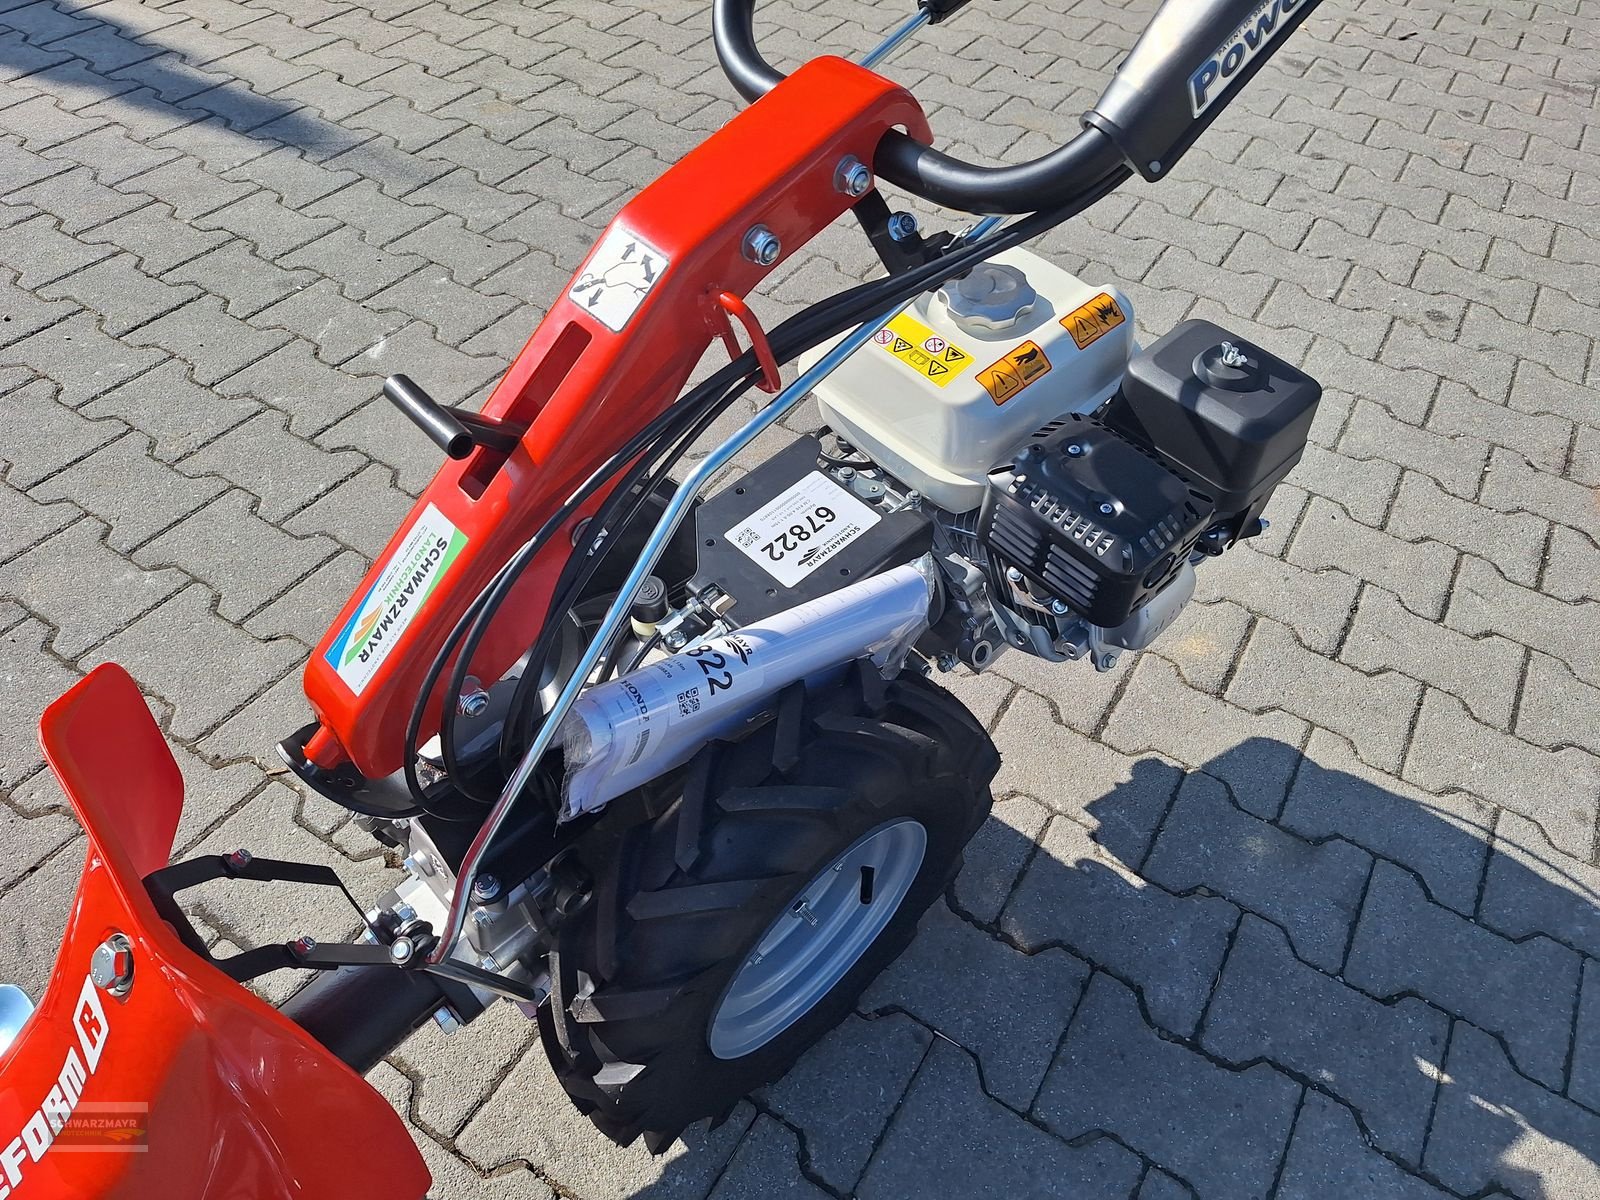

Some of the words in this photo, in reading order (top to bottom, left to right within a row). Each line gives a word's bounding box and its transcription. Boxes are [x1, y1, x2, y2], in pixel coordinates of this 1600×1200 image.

[1217, 30, 1243, 57] PATENT
[760, 506, 836, 561] 67822
[805, 525, 861, 567] SCHWARZMAYR
[383, 531, 437, 606] LANDTECHNIK
[357, 536, 448, 664] SCHWARZMAYR
